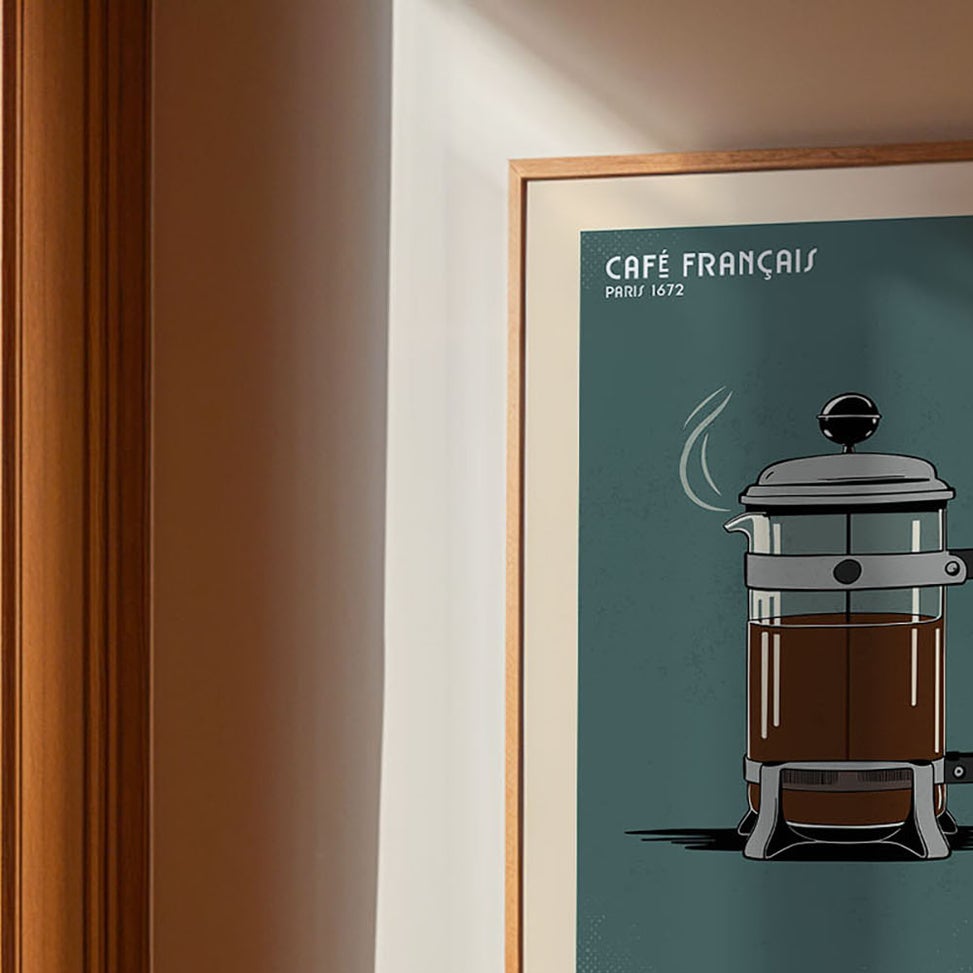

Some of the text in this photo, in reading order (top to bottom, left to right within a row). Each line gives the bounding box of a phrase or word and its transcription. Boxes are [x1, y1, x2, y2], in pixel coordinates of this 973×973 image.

[605, 247, 819, 281] CAFÉ FRANÇAIS
[605, 283, 685, 299] PARIS 1672
